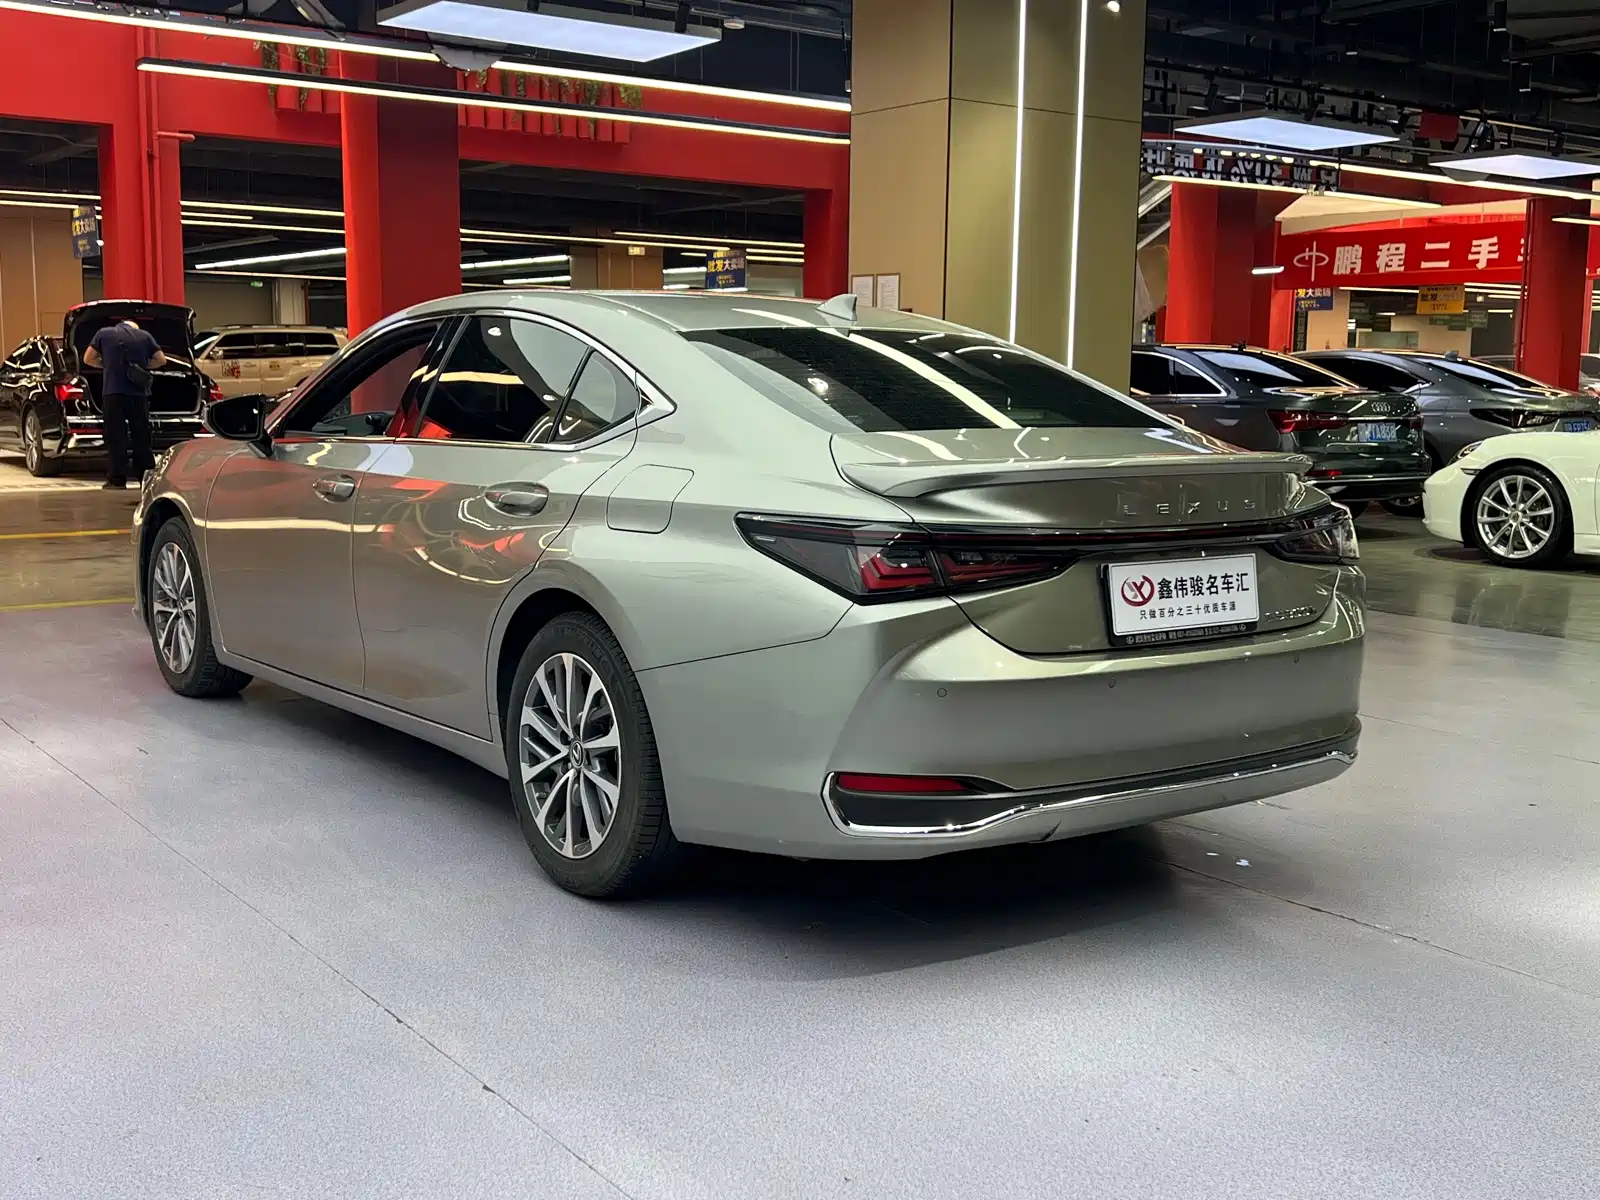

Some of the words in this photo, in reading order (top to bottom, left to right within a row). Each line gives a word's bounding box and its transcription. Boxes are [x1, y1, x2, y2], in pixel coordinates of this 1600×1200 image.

[1333, 236, 1528, 275] 鹏程二手
[1123, 499, 1256, 515] LEXUS
[1157, 572, 1250, 600] 鑫伟骏名车汇
[1139, 601, 1236, 620] 只做百分之三十优质车源
